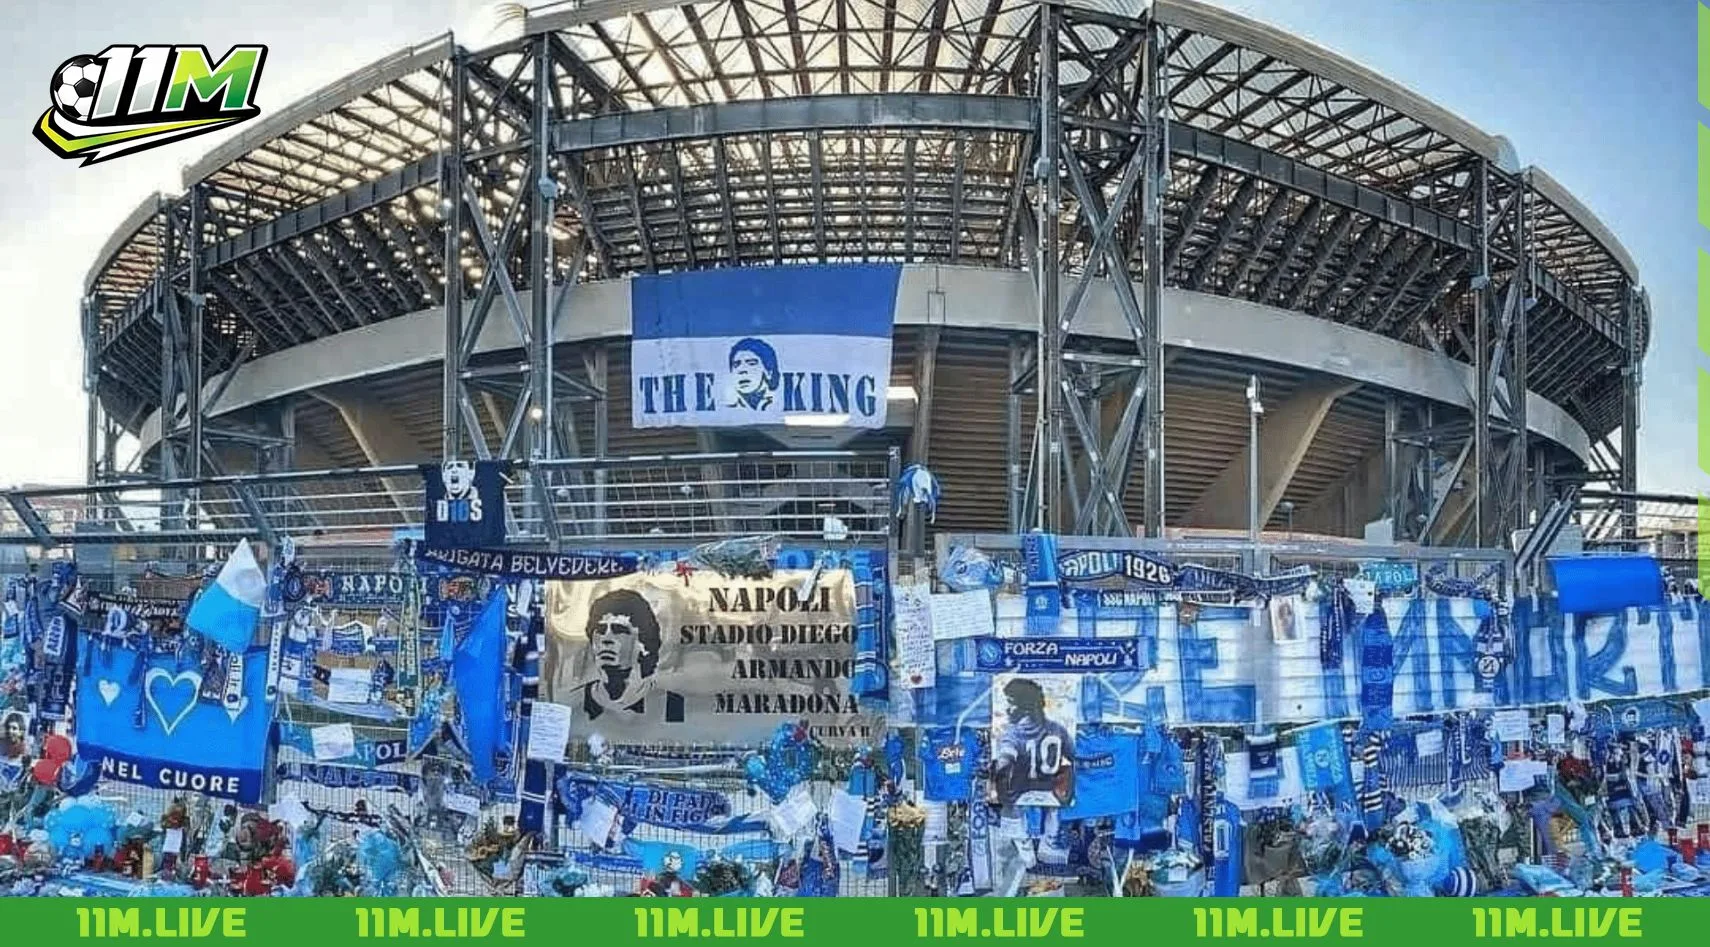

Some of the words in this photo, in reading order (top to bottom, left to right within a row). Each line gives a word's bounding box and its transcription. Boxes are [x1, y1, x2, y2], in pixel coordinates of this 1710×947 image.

[640, 373, 716, 414] THE
[782, 372, 877, 417] KING
[1123, 553, 1172, 584] 1926
[680, 623, 774, 644] STADIO
[780, 623, 859, 645] DIEGO
[1003, 641, 1059, 655] FORZA
[1063, 652, 1118, 667] NAPOLI
[714, 692, 859, 714] MARADONA
[1025, 735, 1062, 779] 10
[102, 755, 143, 780] NEL
[158, 767, 241, 794] CUORE
